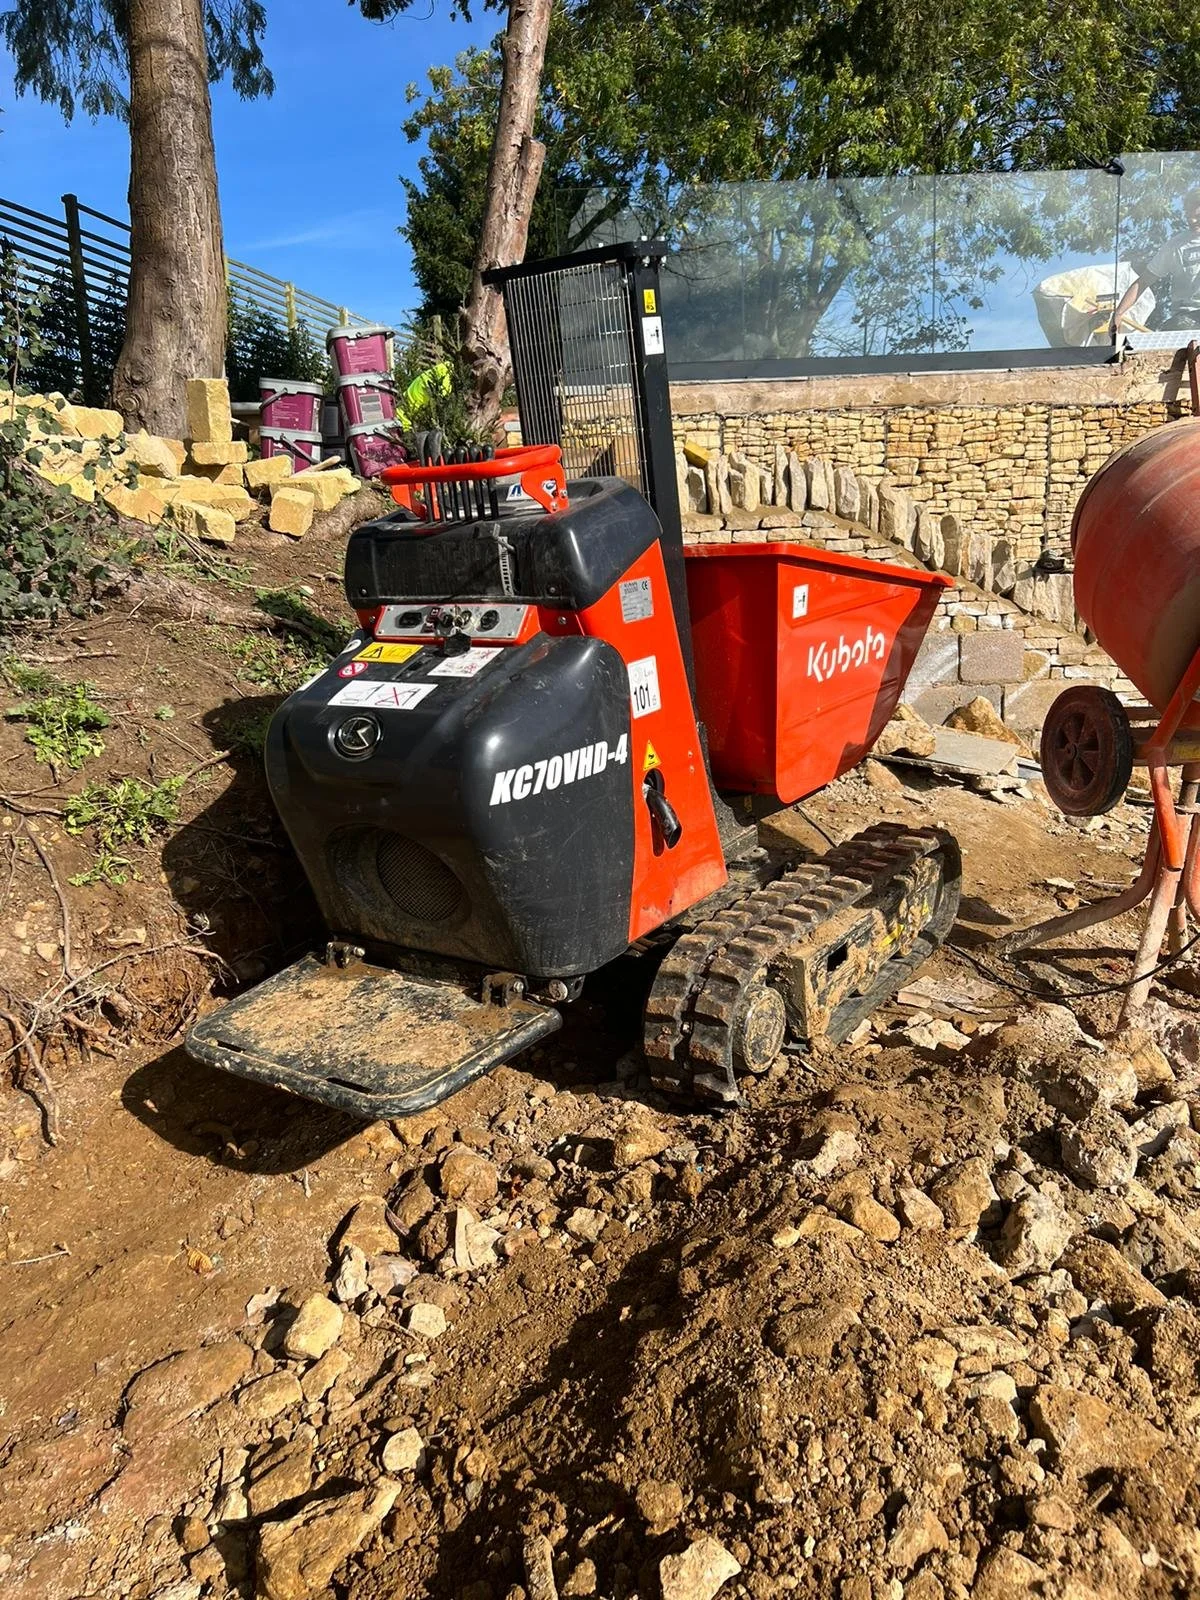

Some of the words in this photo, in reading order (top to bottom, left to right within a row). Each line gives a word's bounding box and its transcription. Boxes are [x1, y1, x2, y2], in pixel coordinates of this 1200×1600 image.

[641, 580, 649, 591] CE
[807, 625, 885, 683] Kubota
[633, 683, 651, 712] 101
[489, 733, 628, 806] KC70VHD-4
